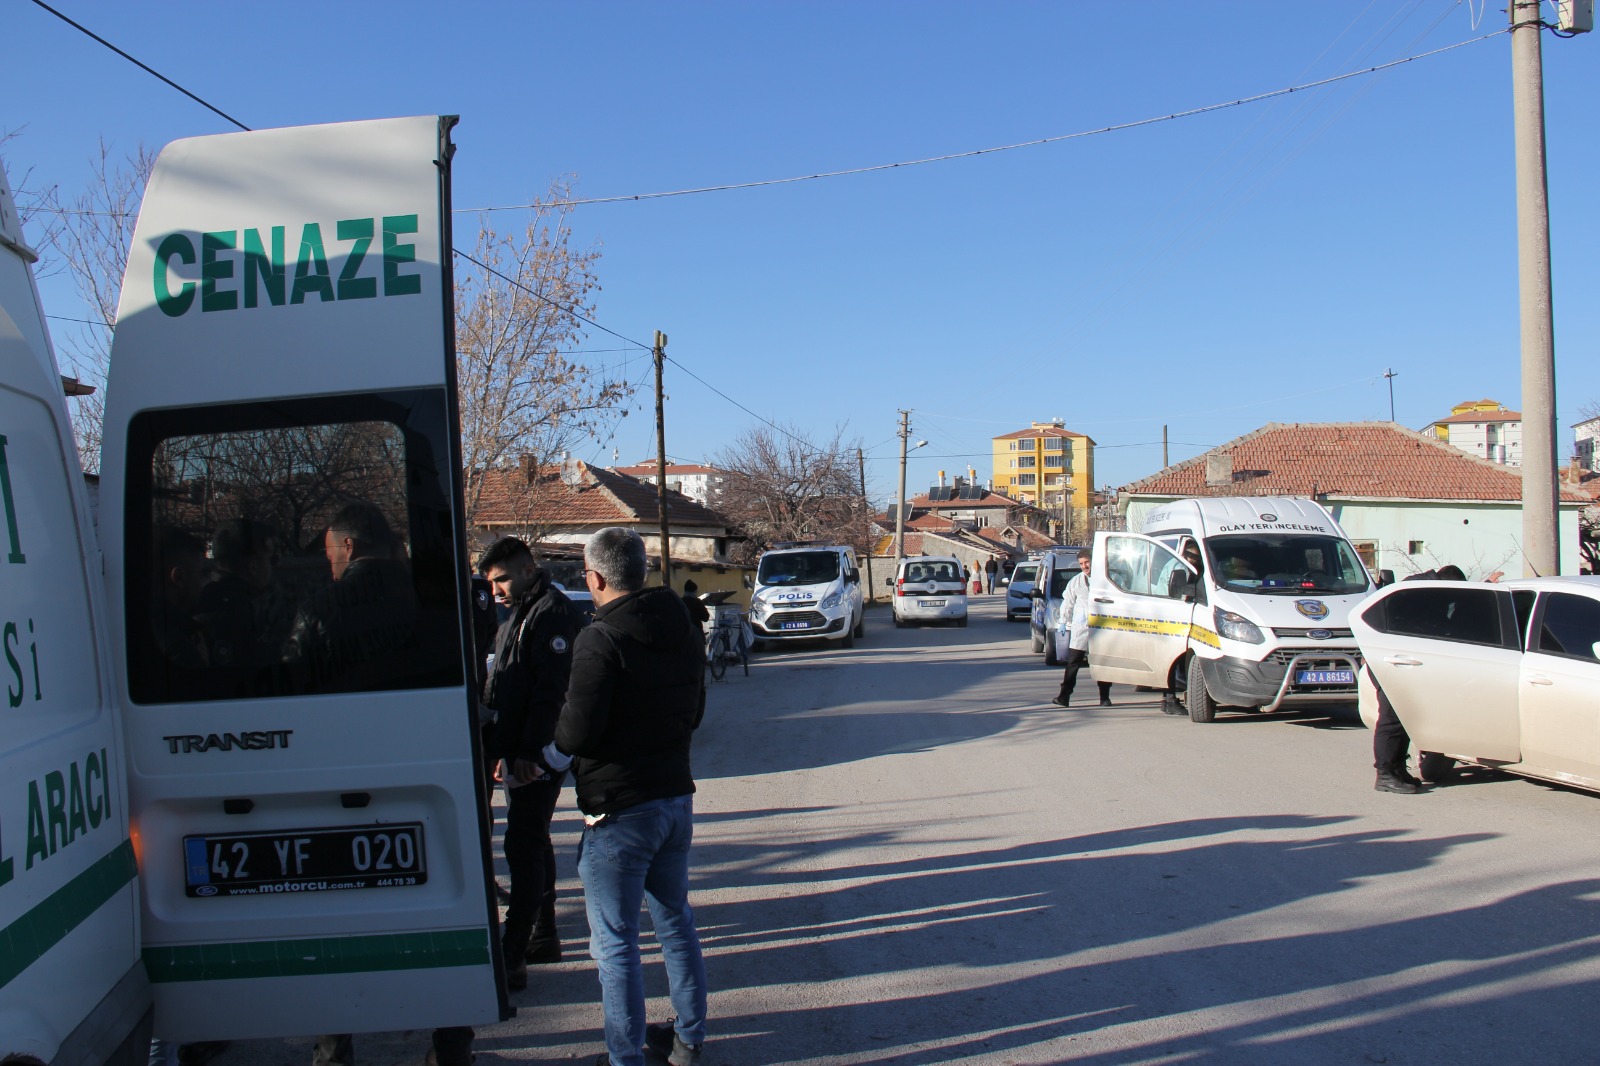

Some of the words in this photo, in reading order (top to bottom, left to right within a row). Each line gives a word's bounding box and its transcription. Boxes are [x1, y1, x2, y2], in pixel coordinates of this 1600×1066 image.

[153, 214, 421, 317] CENAZE
[1219, 524, 1246, 532] OLAY
[1307, 672, 1317, 682] 42
[1319, 672, 1324, 682] A
[1326, 671, 1351, 682] 86154
[163, 730, 294, 754] TRANSIT
[26, 748, 111, 871] ARACI
[212, 842, 249, 879] 42
[274, 838, 311, 876] YF
[352, 833, 414, 871] 020
[229, 880, 366, 895] www.motorcu.com.tr
[377, 878, 392, 887] 444
[405, 876, 416, 885] 39
